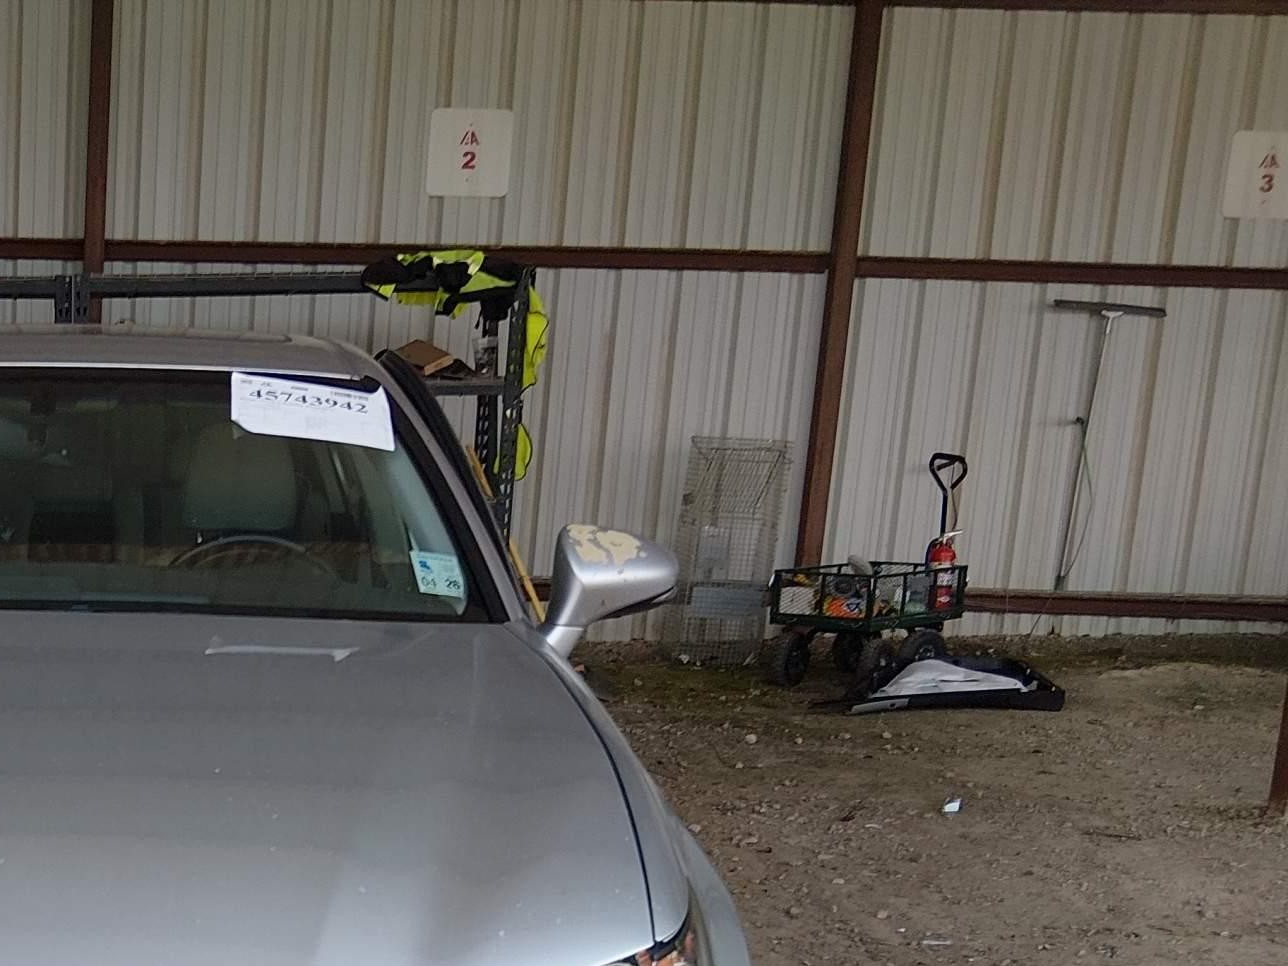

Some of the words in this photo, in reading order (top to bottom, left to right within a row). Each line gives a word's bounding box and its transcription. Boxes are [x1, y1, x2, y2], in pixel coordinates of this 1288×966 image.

[461, 151, 477, 170] 2
[1258, 174, 1275, 193] 3
[248, 389, 368, 415] 45743942
